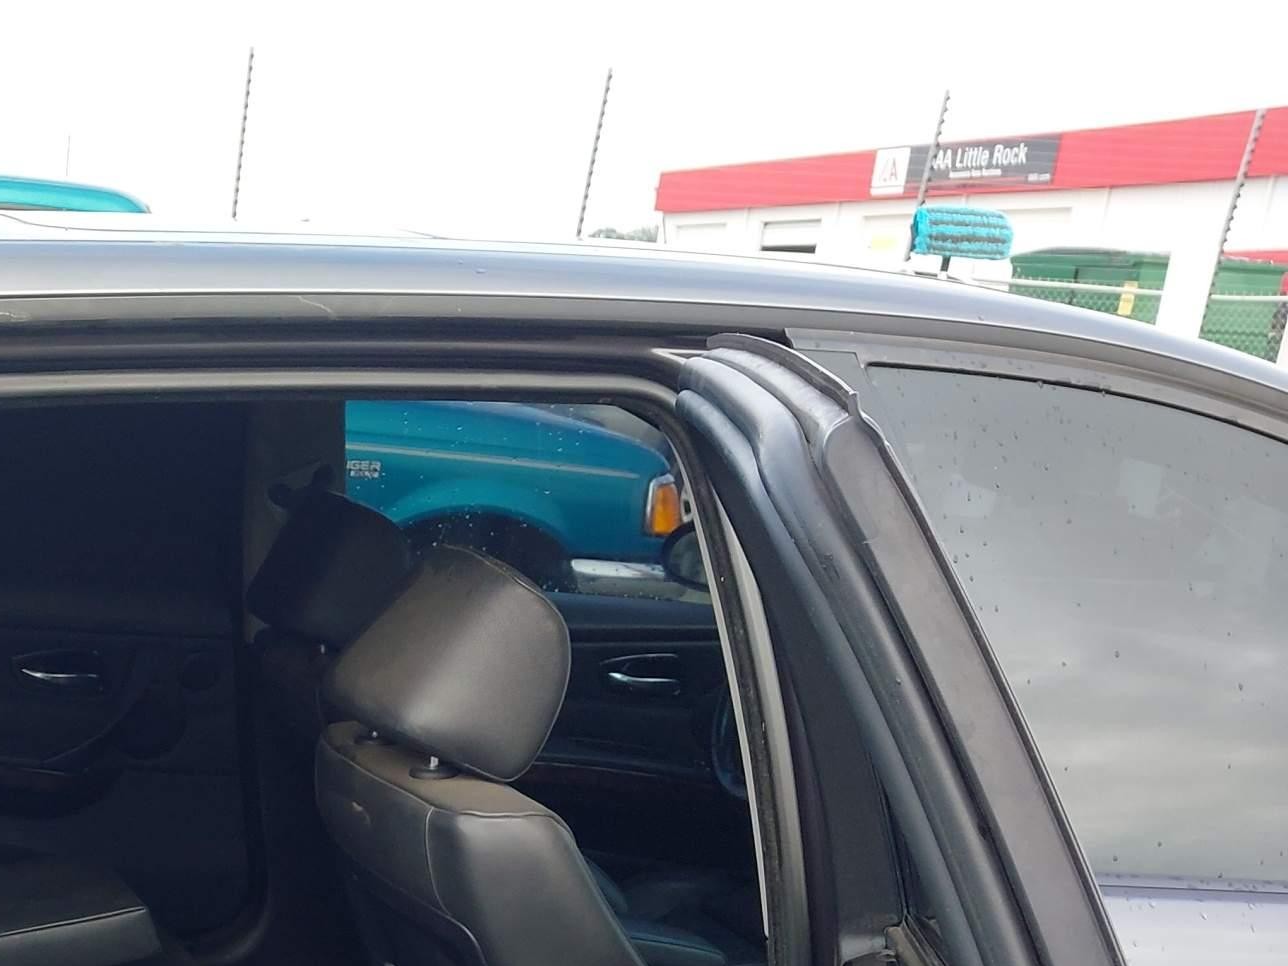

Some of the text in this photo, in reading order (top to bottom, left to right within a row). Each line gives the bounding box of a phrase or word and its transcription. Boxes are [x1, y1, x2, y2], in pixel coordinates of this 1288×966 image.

[933, 142, 1029, 171] AA Little Rock
